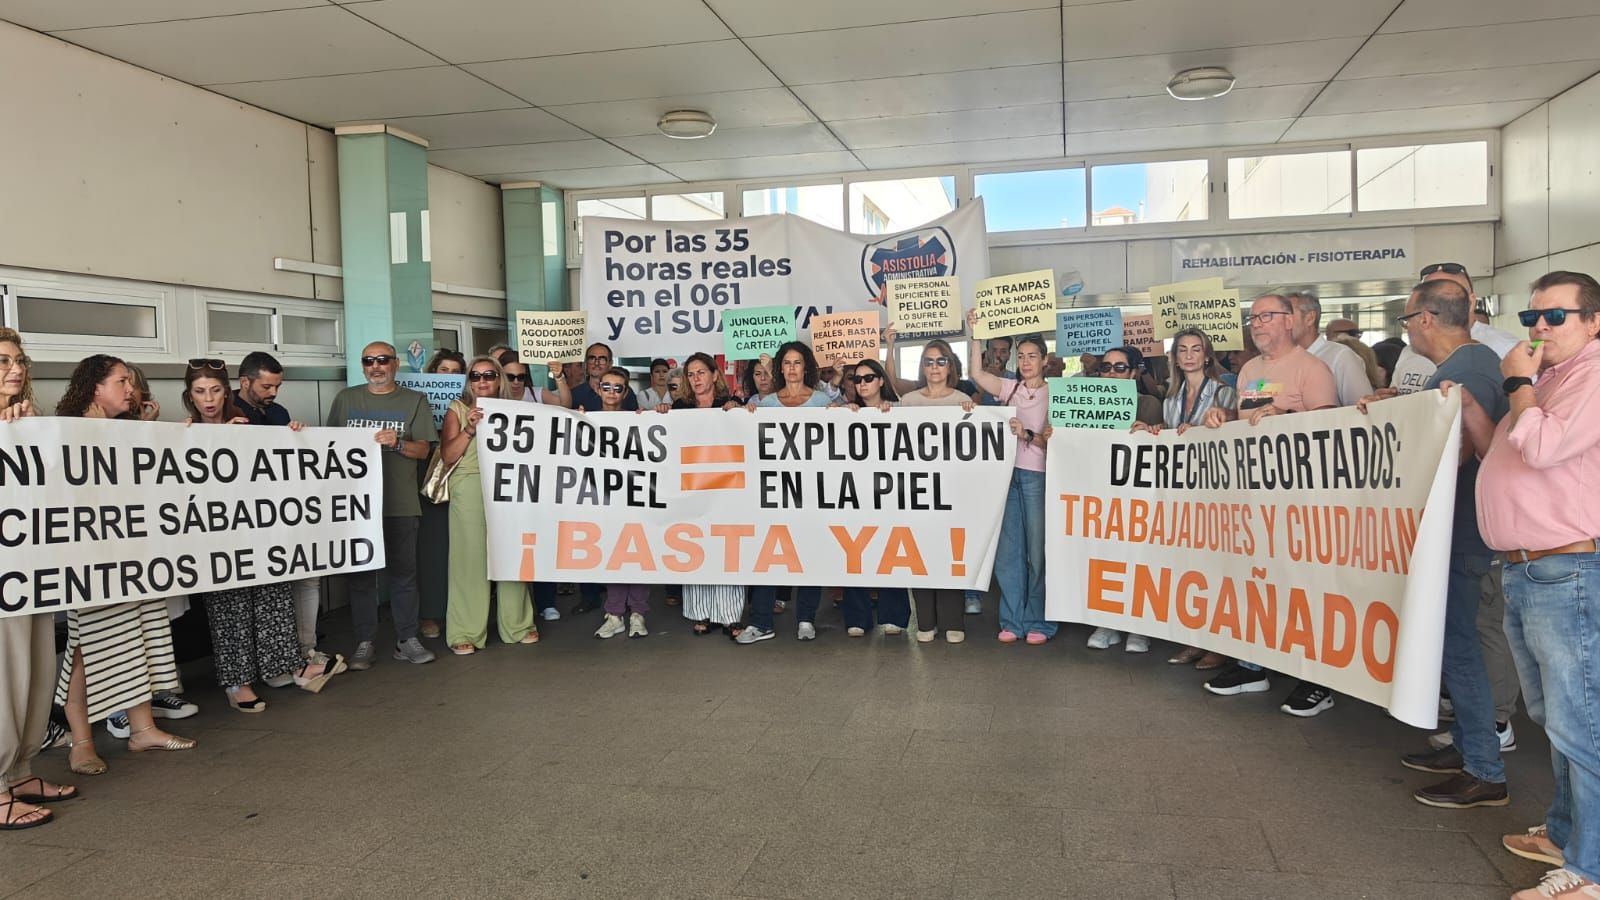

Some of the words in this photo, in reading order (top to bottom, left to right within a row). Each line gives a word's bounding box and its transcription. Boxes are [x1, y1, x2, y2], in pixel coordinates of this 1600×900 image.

[604, 230, 656, 253] Por
[665, 229, 707, 253] las
[714, 228, 750, 252] 35
[882, 253, 937, 272] ASISTOLIA
[1182, 251, 1297, 269] REHABILITACIÓN
[1307, 248, 1406, 264] FISIOTERAPIA
[605, 256, 692, 281] horas
[701, 254, 792, 280] reales
[883, 266, 938, 281] ADMINISTRATIVA
[894, 282, 907, 291] SIN
[908, 280, 951, 290] PERSONAL
[976, 288, 993, 299] CON
[995, 279, 1050, 295] TRAMPAS
[606, 287, 646, 307] en
[654, 283, 681, 307] el
[690, 282, 742, 305] 061
[894, 290, 940, 300] SUFICIENTE
[940, 289, 951, 297] EL
[979, 300, 991, 308] EN
[994, 297, 1011, 306] LAS
[1013, 292, 1046, 304] HORAS
[898, 299, 948, 311] PELIGRO
[1177, 302, 1188, 310] CON
[1188, 298, 1236, 310] TRAMPAS
[898, 312, 910, 321] LO
[911, 311, 938, 320] SUFRE
[939, 310, 949, 318] EL
[975, 311, 986, 320] LA
[987, 302, 1053, 318] CONCILIACIÓN
[1075, 311, 1113, 321] PERSONAL
[1161, 307, 1177, 317] AFL
[1180, 313, 1188, 321] EN
[1188, 313, 1200, 321] LAS
[1202, 311, 1232, 320] HORAS
[520, 318, 585, 326] TRABAJADORES
[606, 315, 626, 340] y
[634, 310, 661, 334] el
[671, 309, 725, 334] SU
[729, 315, 789, 327] JUNQUERA,
[822, 320, 832, 329] 35
[832, 318, 864, 327] HORAS
[905, 320, 944, 329] PACIENTE
[988, 315, 1040, 330] EMPEORA
[1063, 320, 1104, 330] SUFICIENTE
[1123, 319, 1150, 328] HORAS
[521, 328, 585, 337] AGODOTADOS
[732, 328, 772, 339] AFLOJA
[774, 327, 788, 336] LA
[813, 329, 846, 340] REALES,
[847, 327, 877, 336] BASTA
[1067, 328, 1112, 340] PELIGRO
[1136, 327, 1155, 335] BAS
[535, 339, 568, 347] SUFREN
[569, 338, 583, 346] LOS
[735, 340, 784, 351] CARTERA
[815, 344, 825, 353] DE
[826, 339, 876, 351] TRAMPAS
[1123, 337, 1161, 346] RAMPA
[523, 348, 582, 359] CIUDADANOS
[1071, 345, 1107, 353] PACIENTE
[825, 351, 865, 361] FISCALES
[395, 381, 462, 389] RABAJADORES
[1402, 372, 1432, 387] DELI
[1066, 384, 1078, 392] 35
[1080, 384, 1118, 393] HORAS
[1052, 395, 1096, 406] REALES,
[1098, 396, 1134, 406] BASTA
[1052, 410, 1067, 419] DE
[1069, 409, 1131, 421] TRAMPAS
[486, 412, 535, 454] 35
[549, 415, 668, 463] HORAS
[757, 412, 1005, 461] EXPLOTACIÓN
[1110, 439, 1231, 491] DERECHOS
[1234, 422, 1402, 490] RECORTADOS:
[0, 445, 46, 486] NI
[62, 445, 118, 486] UN
[132, 447, 239, 485] PASO
[250, 440, 369, 482] ATRÁS
[493, 462, 541, 503] EN
[554, 465, 667, 509] PAPEL
[759, 470, 803, 509] EN
[816, 471, 860, 510] LA
[873, 471, 953, 511] PIEL
[0, 504, 148, 548] CIERRE
[158, 494, 322, 536] SÁBADOS
[330, 493, 372, 523] EN
[1059, 494, 1256, 556] TRABAJADORES
[1259, 504, 1277, 559] Y
[1286, 504, 1427, 576] CIUDADAN
[0, 553, 200, 612] CENTROS
[210, 549, 257, 585] DE
[266, 537, 375, 577] SALUD
